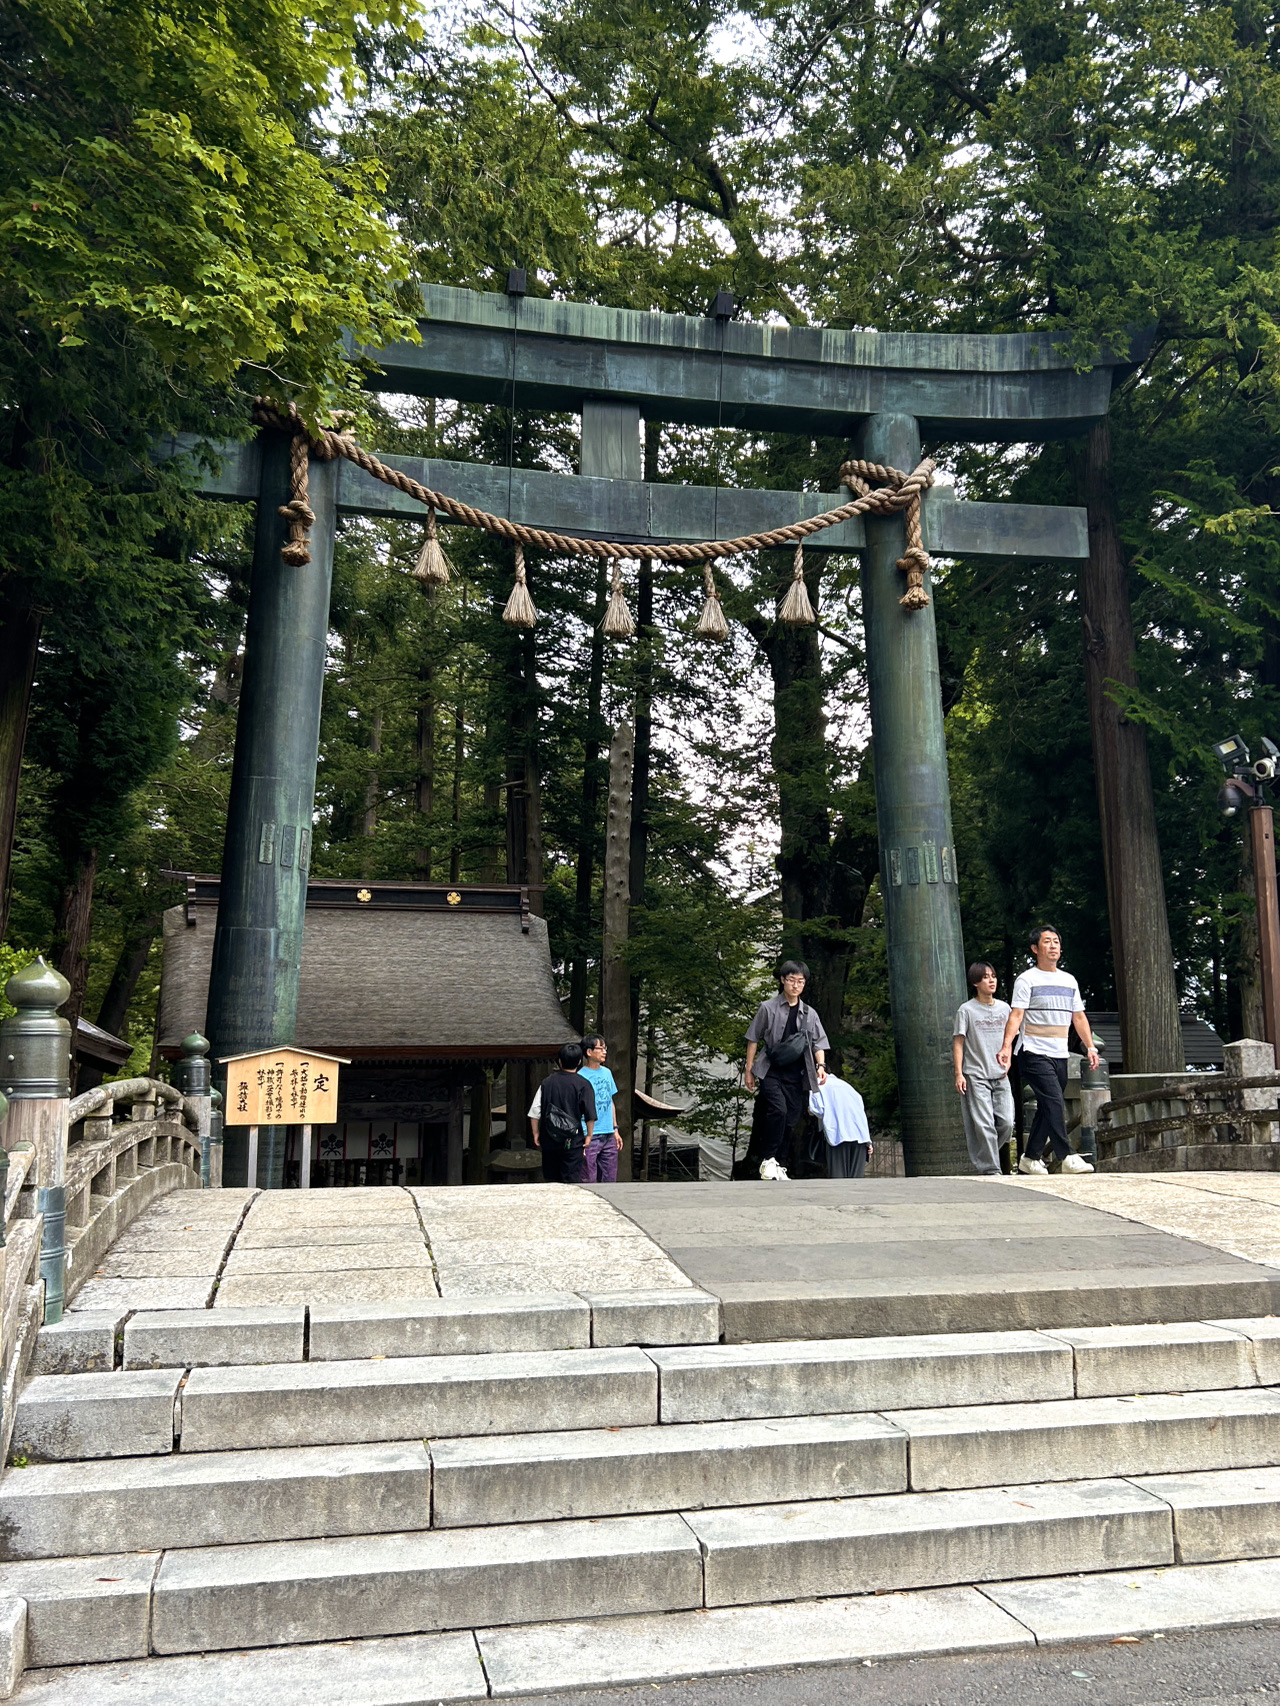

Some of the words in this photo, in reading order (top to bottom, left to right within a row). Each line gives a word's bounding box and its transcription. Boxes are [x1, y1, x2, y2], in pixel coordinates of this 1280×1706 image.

[313, 1073, 329, 1092] 定
[237, 1081, 249, 1112] 諏訪大社
